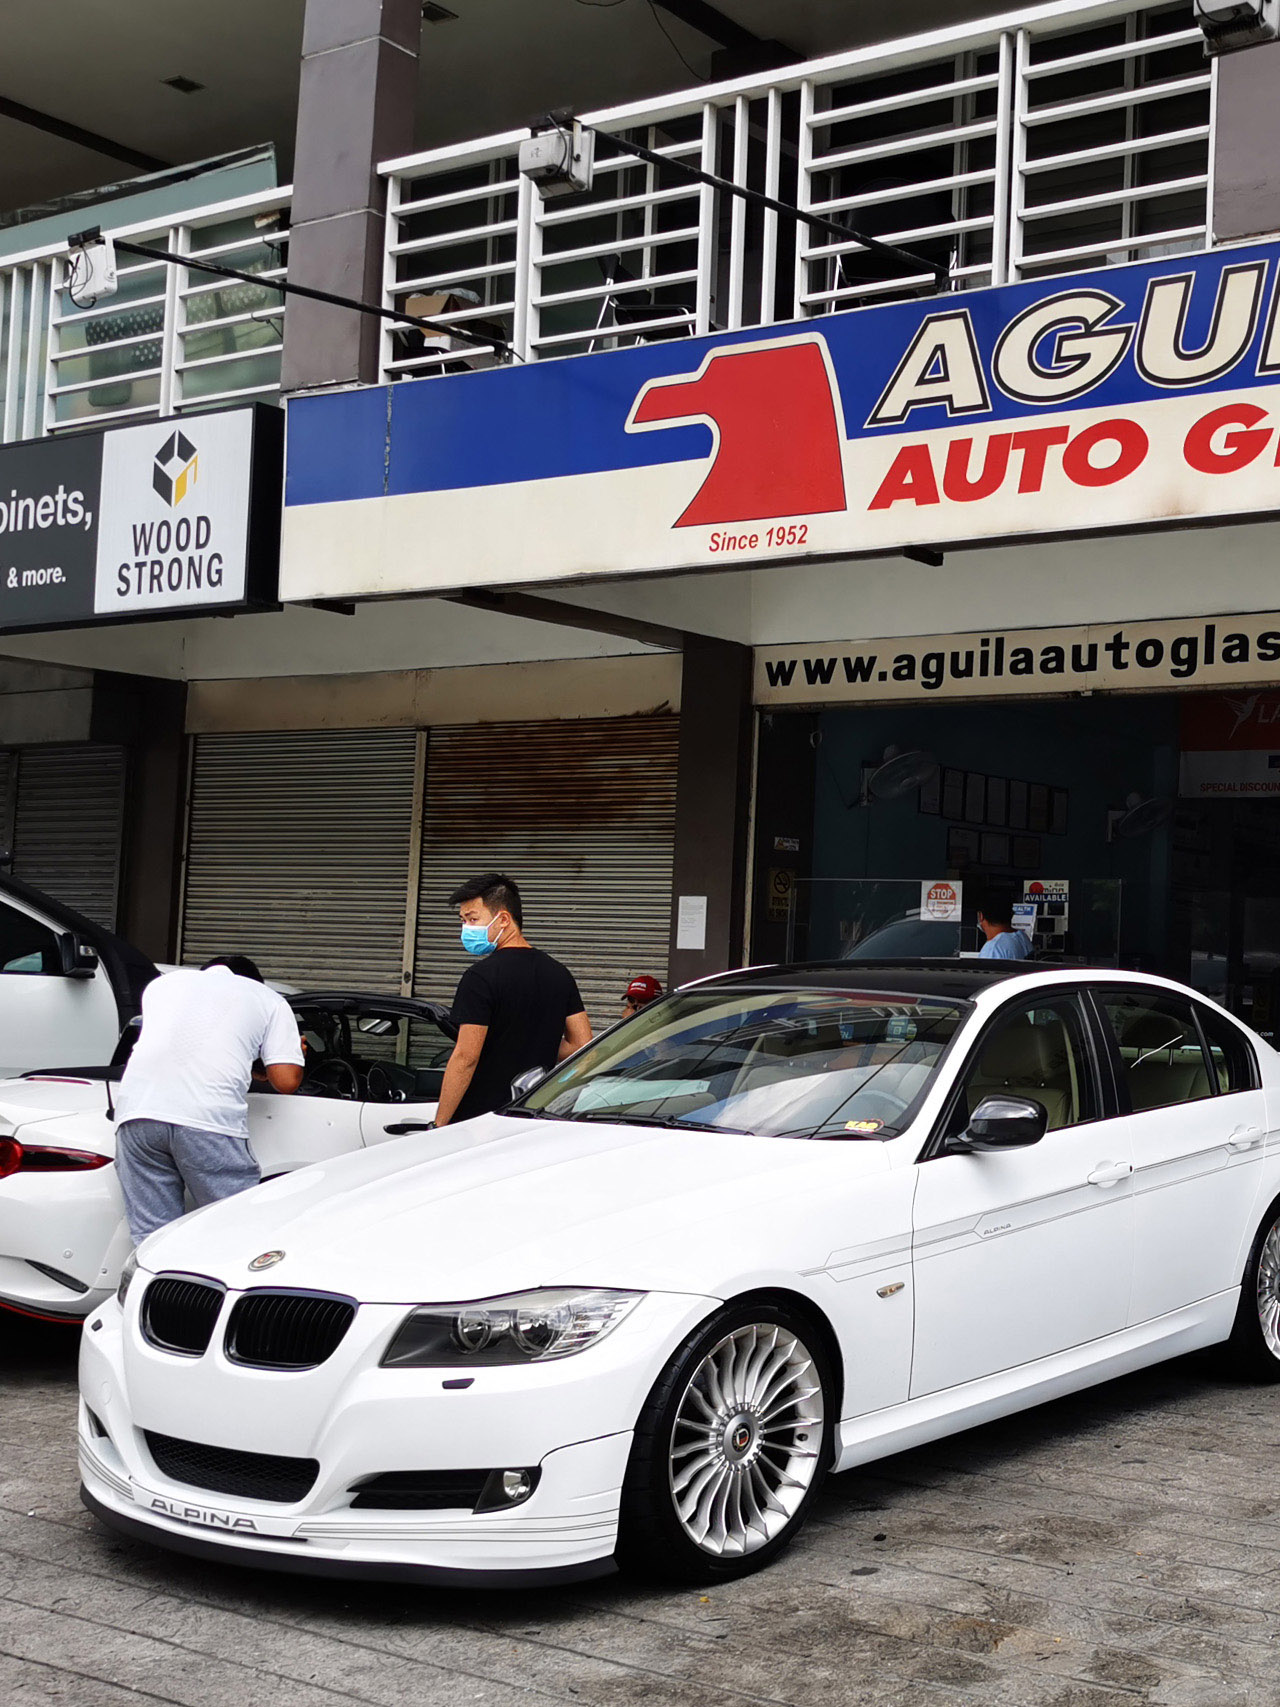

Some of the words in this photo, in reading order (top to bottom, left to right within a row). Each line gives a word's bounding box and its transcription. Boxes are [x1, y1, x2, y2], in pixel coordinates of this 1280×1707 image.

[867, 419, 1150, 511] AUTO
[132, 515, 212, 558] WOOD
[708, 531, 760, 553] Since
[765, 524, 809, 548] 1952
[7, 566, 19, 589] &
[22, 566, 67, 587] more.
[116, 552, 224, 597] STRONG
[1200, 782, 1239, 793] SPECIAL
[930, 888, 953, 899] STOP
[1025, 893, 1067, 902] AVAILABLE
[150, 1498, 258, 1532] ALPINA
